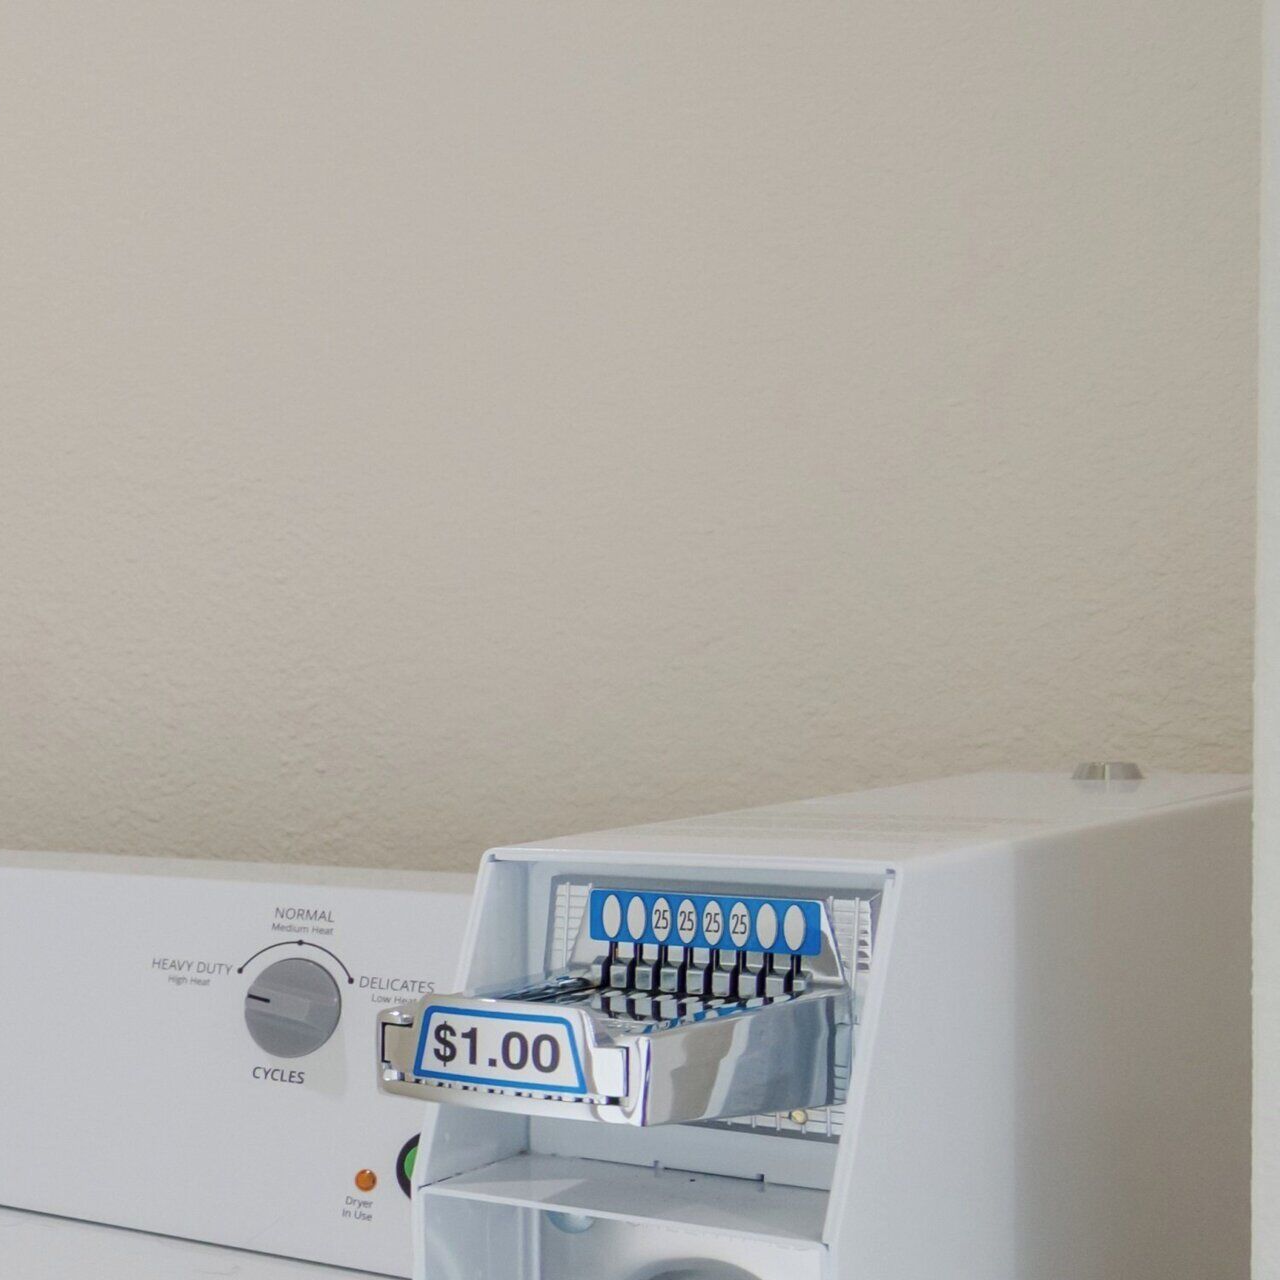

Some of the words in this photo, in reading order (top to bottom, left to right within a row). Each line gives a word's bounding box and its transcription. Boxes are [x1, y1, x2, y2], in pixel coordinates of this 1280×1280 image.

[274, 906, 335, 923] NORMAL
[653, 908, 670, 930] 25
[679, 911, 695, 932] 25
[704, 912, 721, 934] 25
[731, 913, 748, 935] 25
[271, 922, 310, 934] Medium
[312, 925, 334, 936] Heat
[151, 957, 194, 973] HEAVY
[196, 960, 233, 976] DUTY
[167, 974, 188, 986] High
[189, 976, 211, 987] Heat
[359, 975, 435, 995] DELICATES
[371, 993, 392, 1004] Low
[433, 1020, 561, 1074] $1.00
[252, 1066, 305, 1084] CYCLES
[345, 1195, 374, 1209] Dryer
[342, 1208, 352, 1218] In
[354, 1210, 373, 1222] Use
